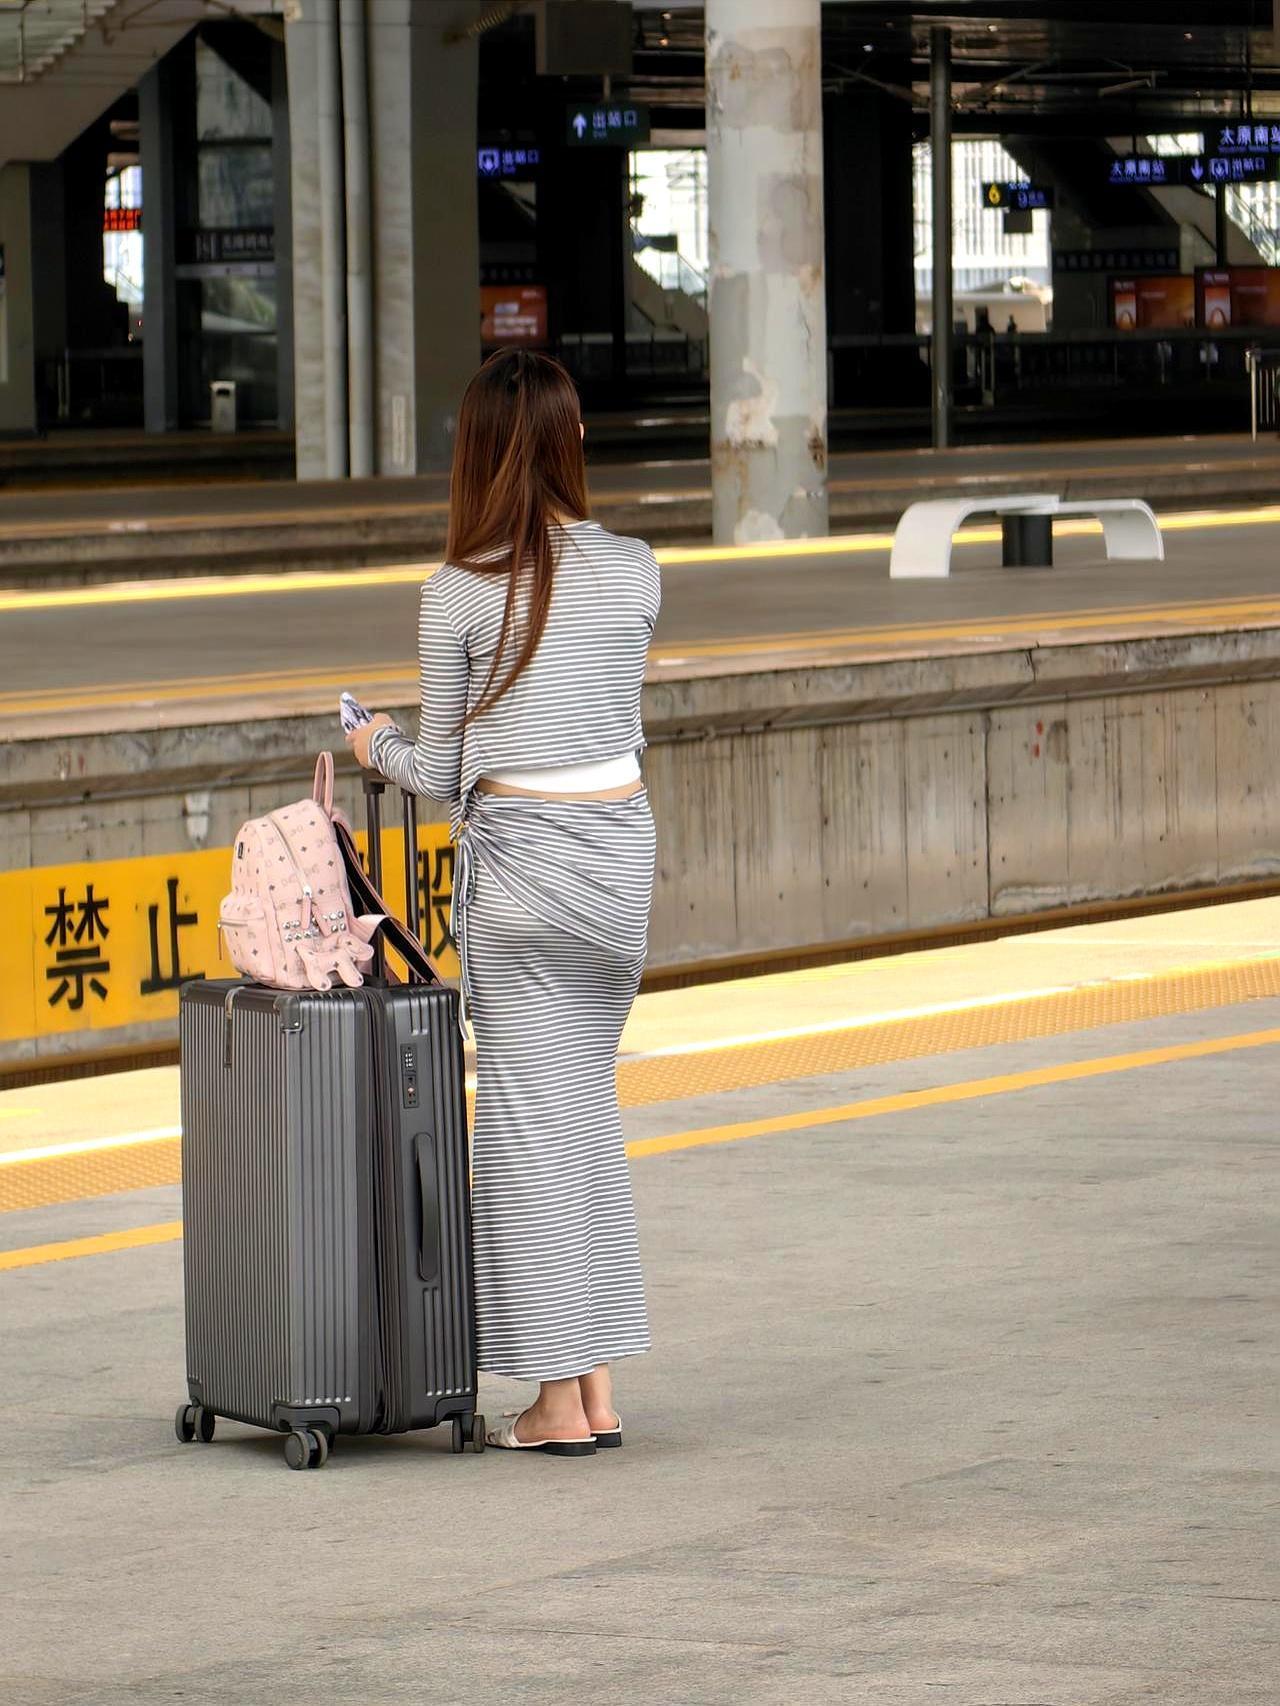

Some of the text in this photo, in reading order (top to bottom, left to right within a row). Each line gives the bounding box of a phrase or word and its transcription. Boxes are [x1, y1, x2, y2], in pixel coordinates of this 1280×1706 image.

[592, 109, 637, 128] 出站口
[502, 149, 539, 165] 出站口
